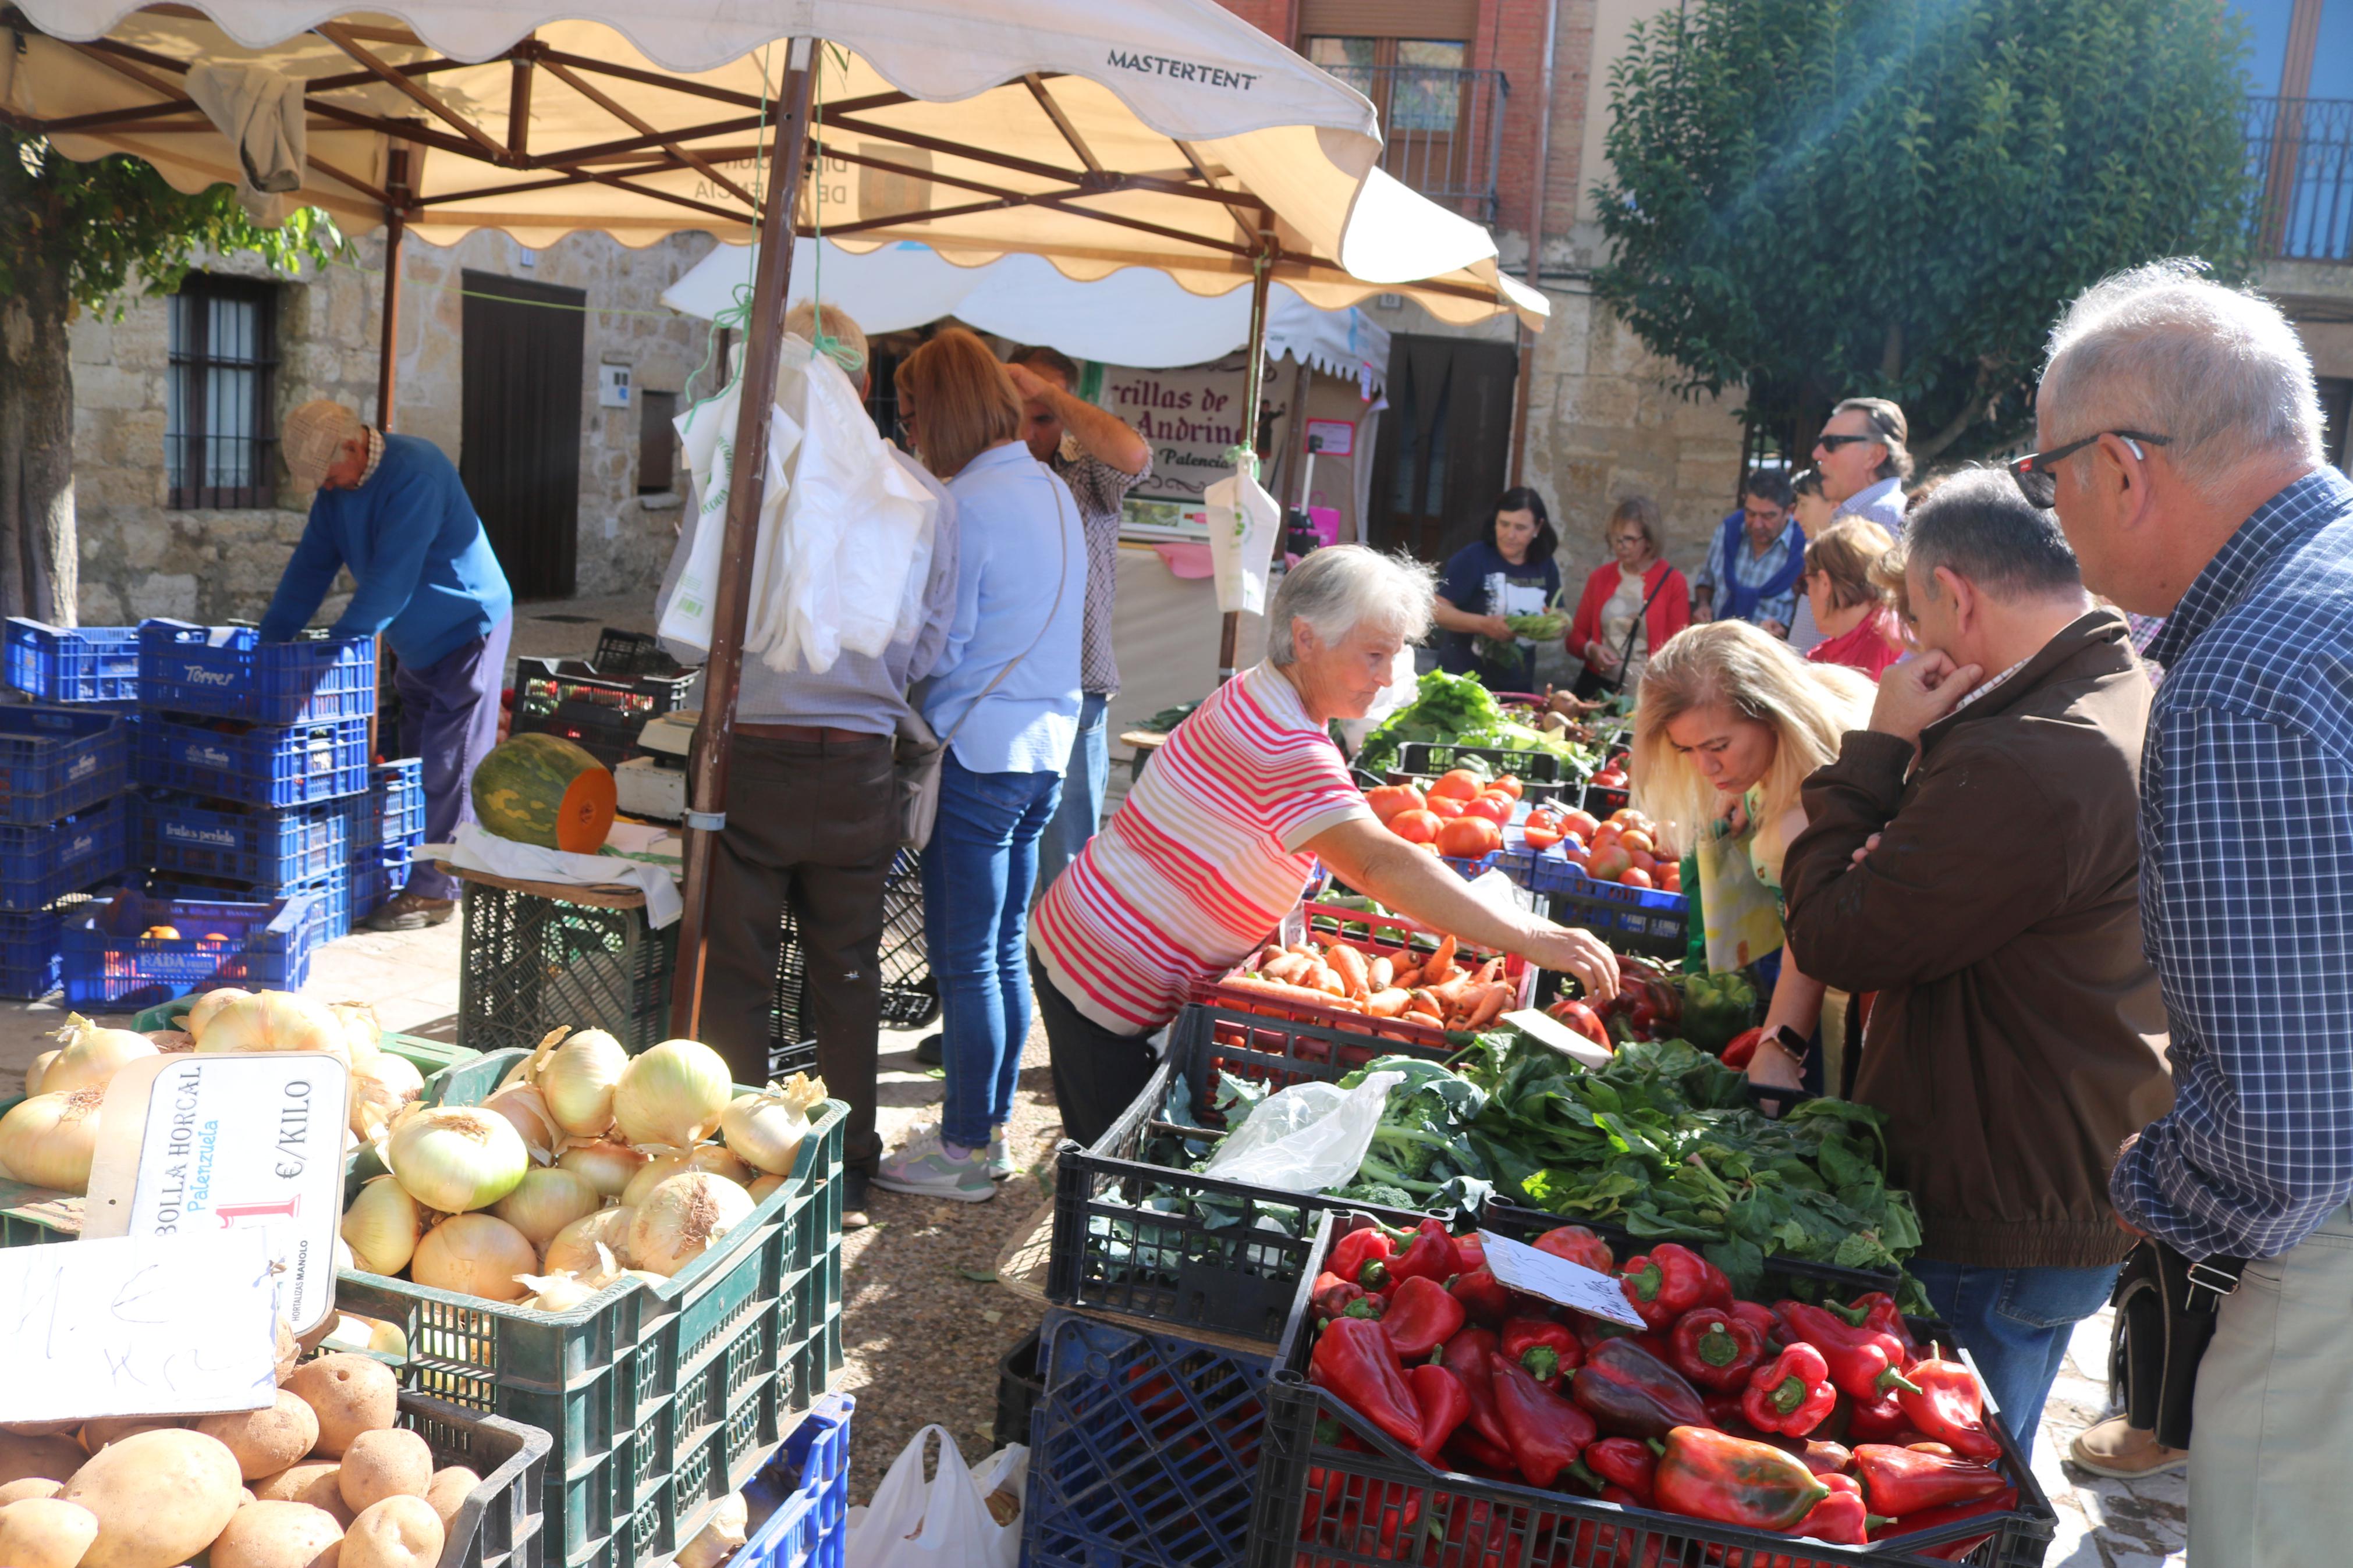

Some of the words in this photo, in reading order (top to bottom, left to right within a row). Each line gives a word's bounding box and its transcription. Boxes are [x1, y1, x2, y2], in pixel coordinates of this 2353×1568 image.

[1107, 49, 1257, 91] MASTERTENT
[1201, 387, 1229, 412] de
[1159, 448, 1232, 469] Palencia
[184, 664, 235, 687] Torres
[168, 1066, 201, 1155] HORCAL
[187, 1120, 218, 1212] Palenzuela
[155, 1163, 189, 1236] BOLLA
[296, 1240, 308, 1280] MANOLO
[292, 1281, 304, 1321] HORTALIZAS
